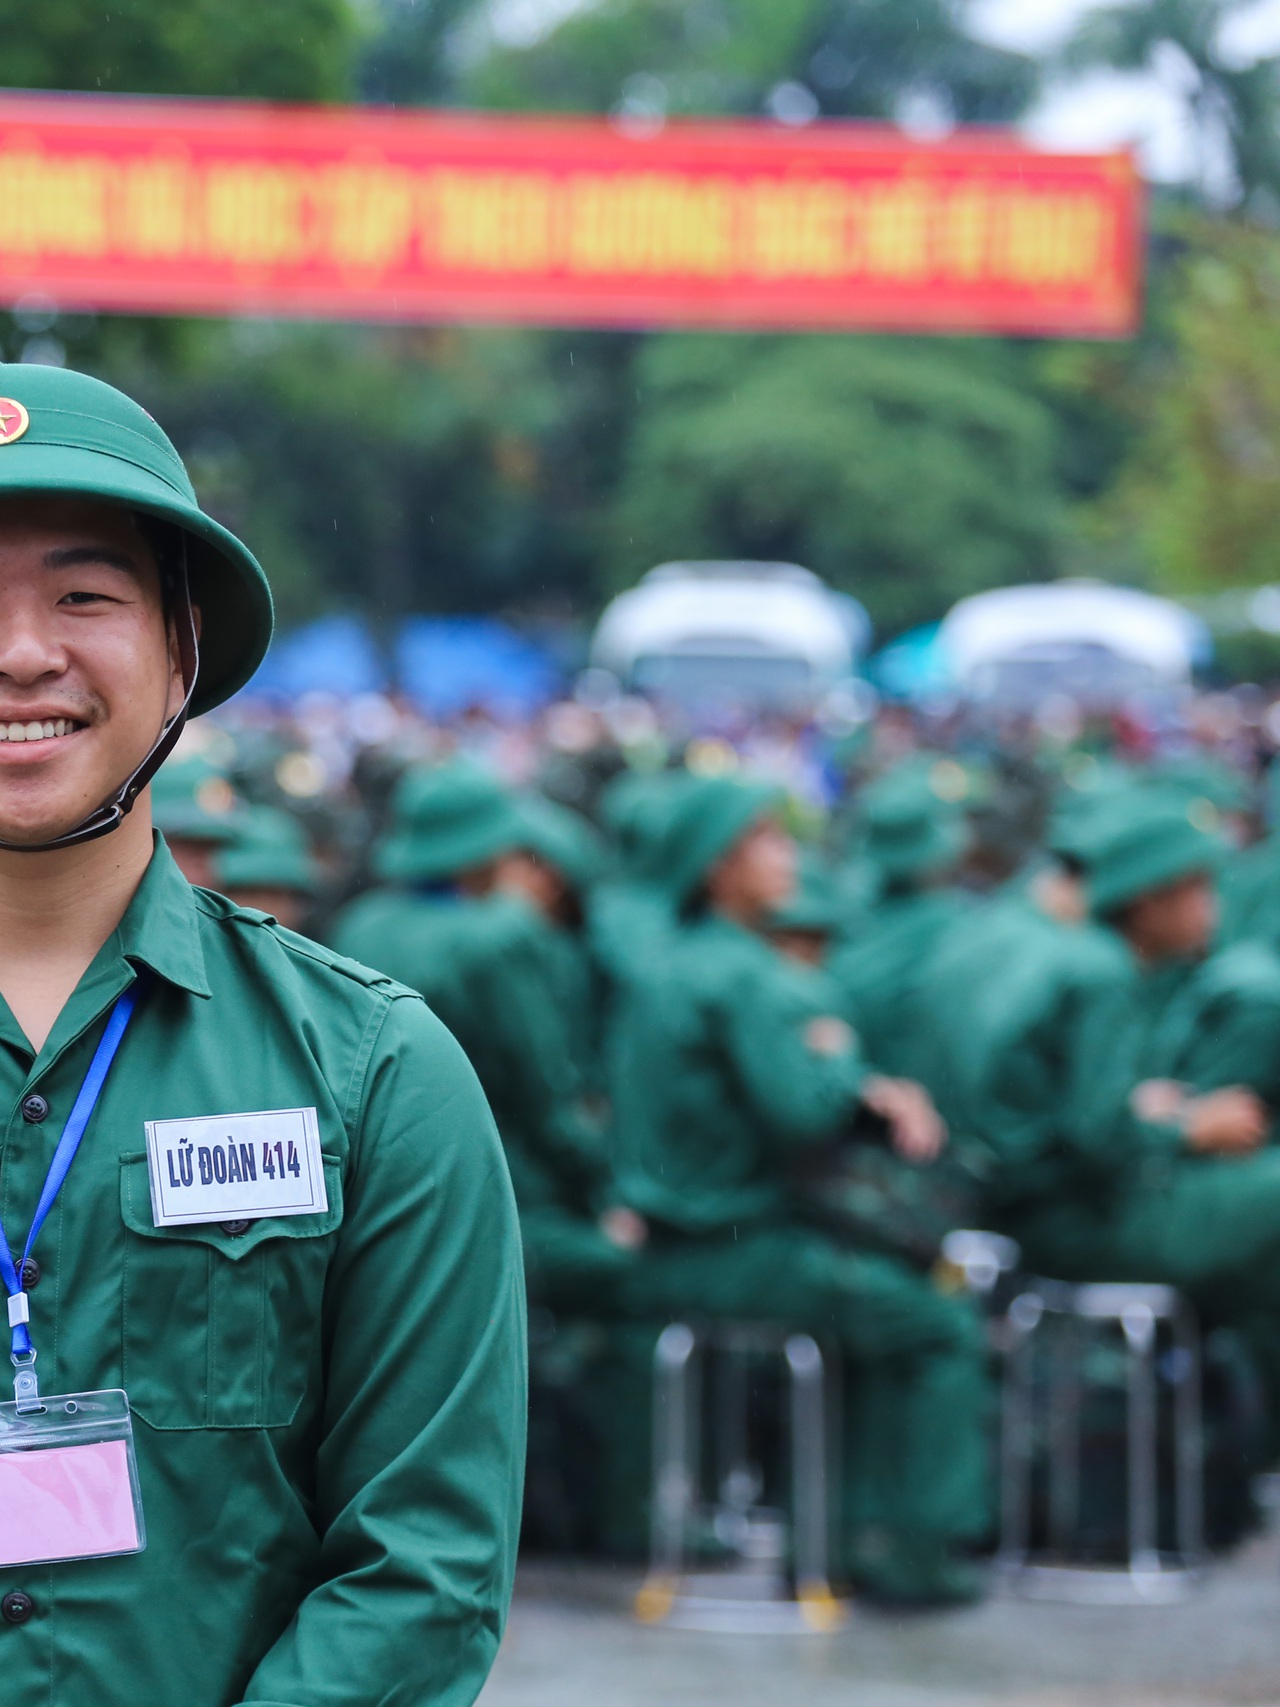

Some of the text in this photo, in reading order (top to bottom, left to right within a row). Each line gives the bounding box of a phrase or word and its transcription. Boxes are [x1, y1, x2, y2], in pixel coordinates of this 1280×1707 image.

[166, 1135, 301, 1188] LỮ ĐOÀN 414
